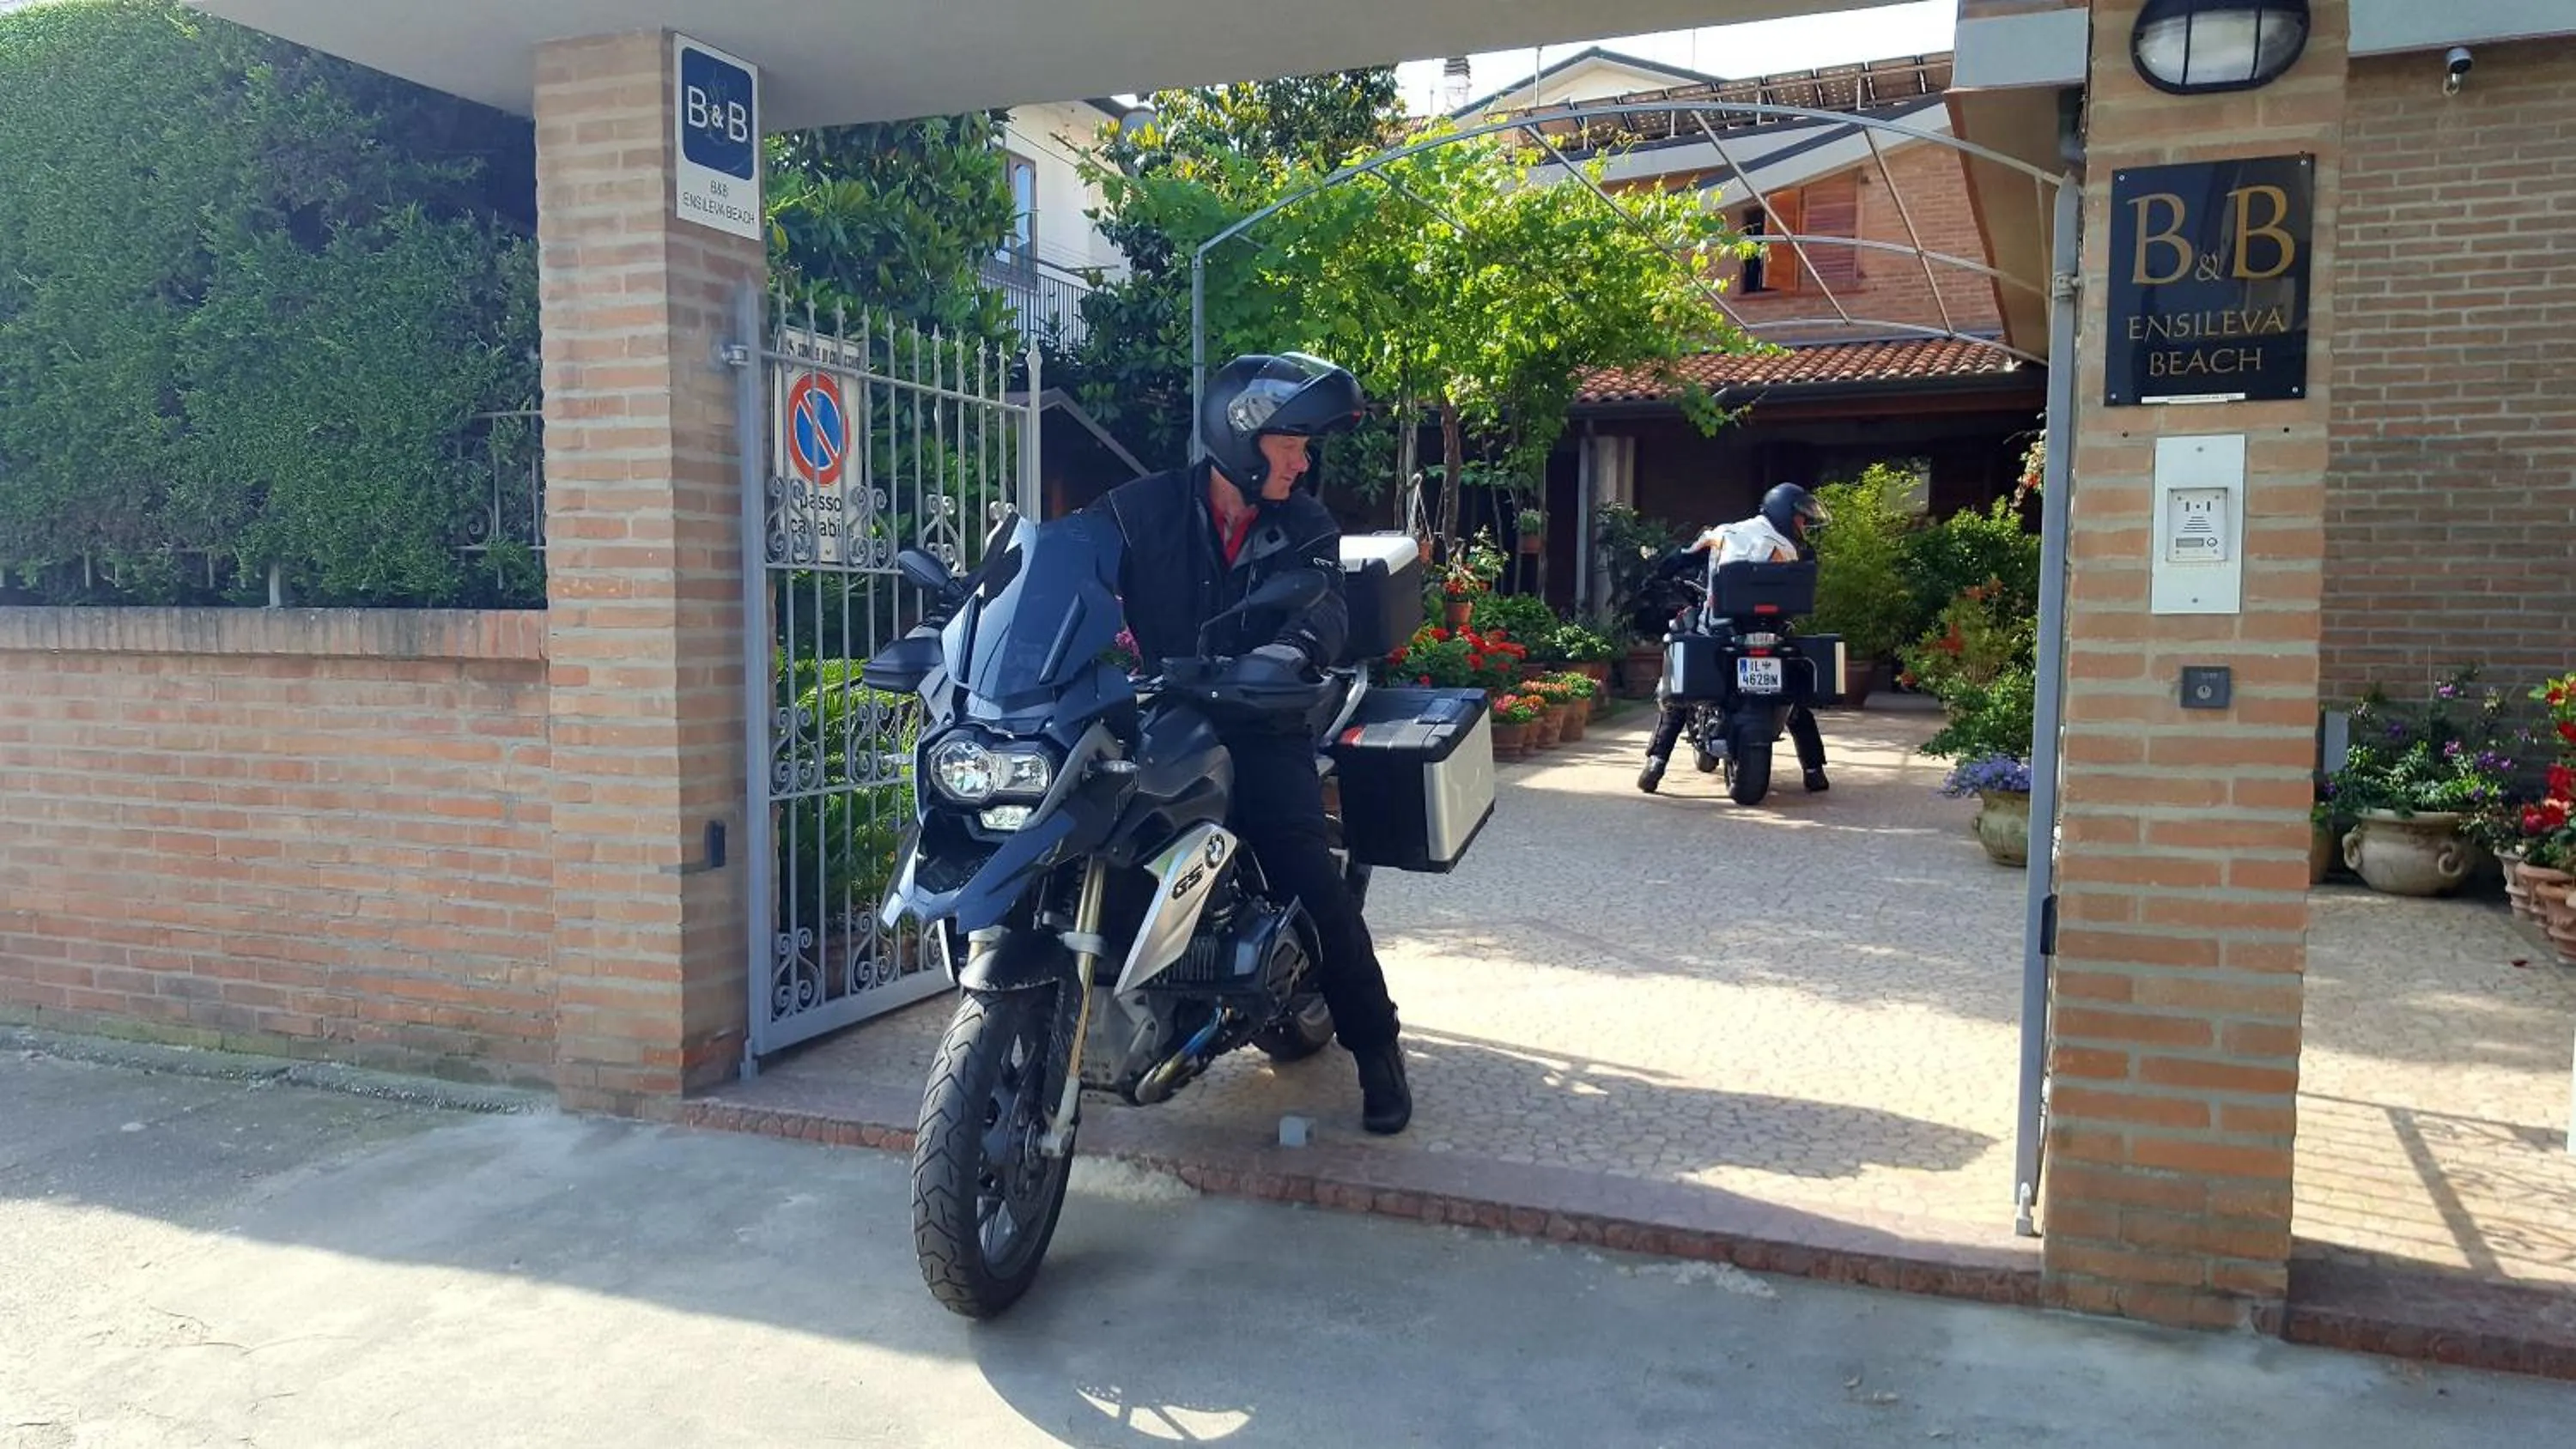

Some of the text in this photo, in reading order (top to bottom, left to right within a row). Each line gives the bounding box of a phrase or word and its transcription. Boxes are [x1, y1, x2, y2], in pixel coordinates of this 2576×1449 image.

[688, 85, 748, 143] B&B
[2126, 185, 2296, 284] B&B
[2128, 307, 2287, 343] ENSILEVA
[2149, 347, 2263, 377] BEACH
[1172, 863, 1204, 900] GS
